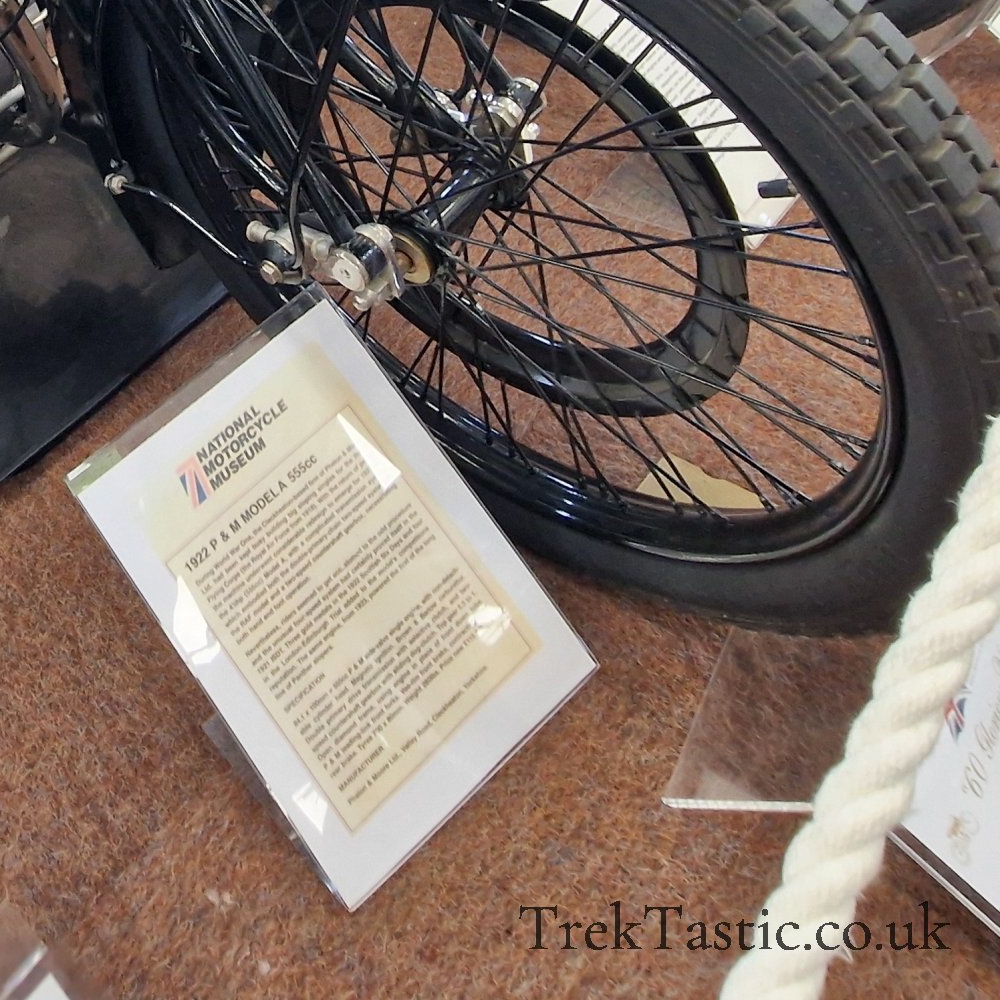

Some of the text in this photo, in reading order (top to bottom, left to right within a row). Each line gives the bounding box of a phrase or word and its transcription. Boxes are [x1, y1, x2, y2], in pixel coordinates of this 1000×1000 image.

[196, 405, 260, 463] NATIONAL
[202, 398, 288, 477] MOTORCYCLE
[209, 437, 266, 491] MUSEUM
[185, 455, 318, 572] 1922 P & M MODEL A 555cc
